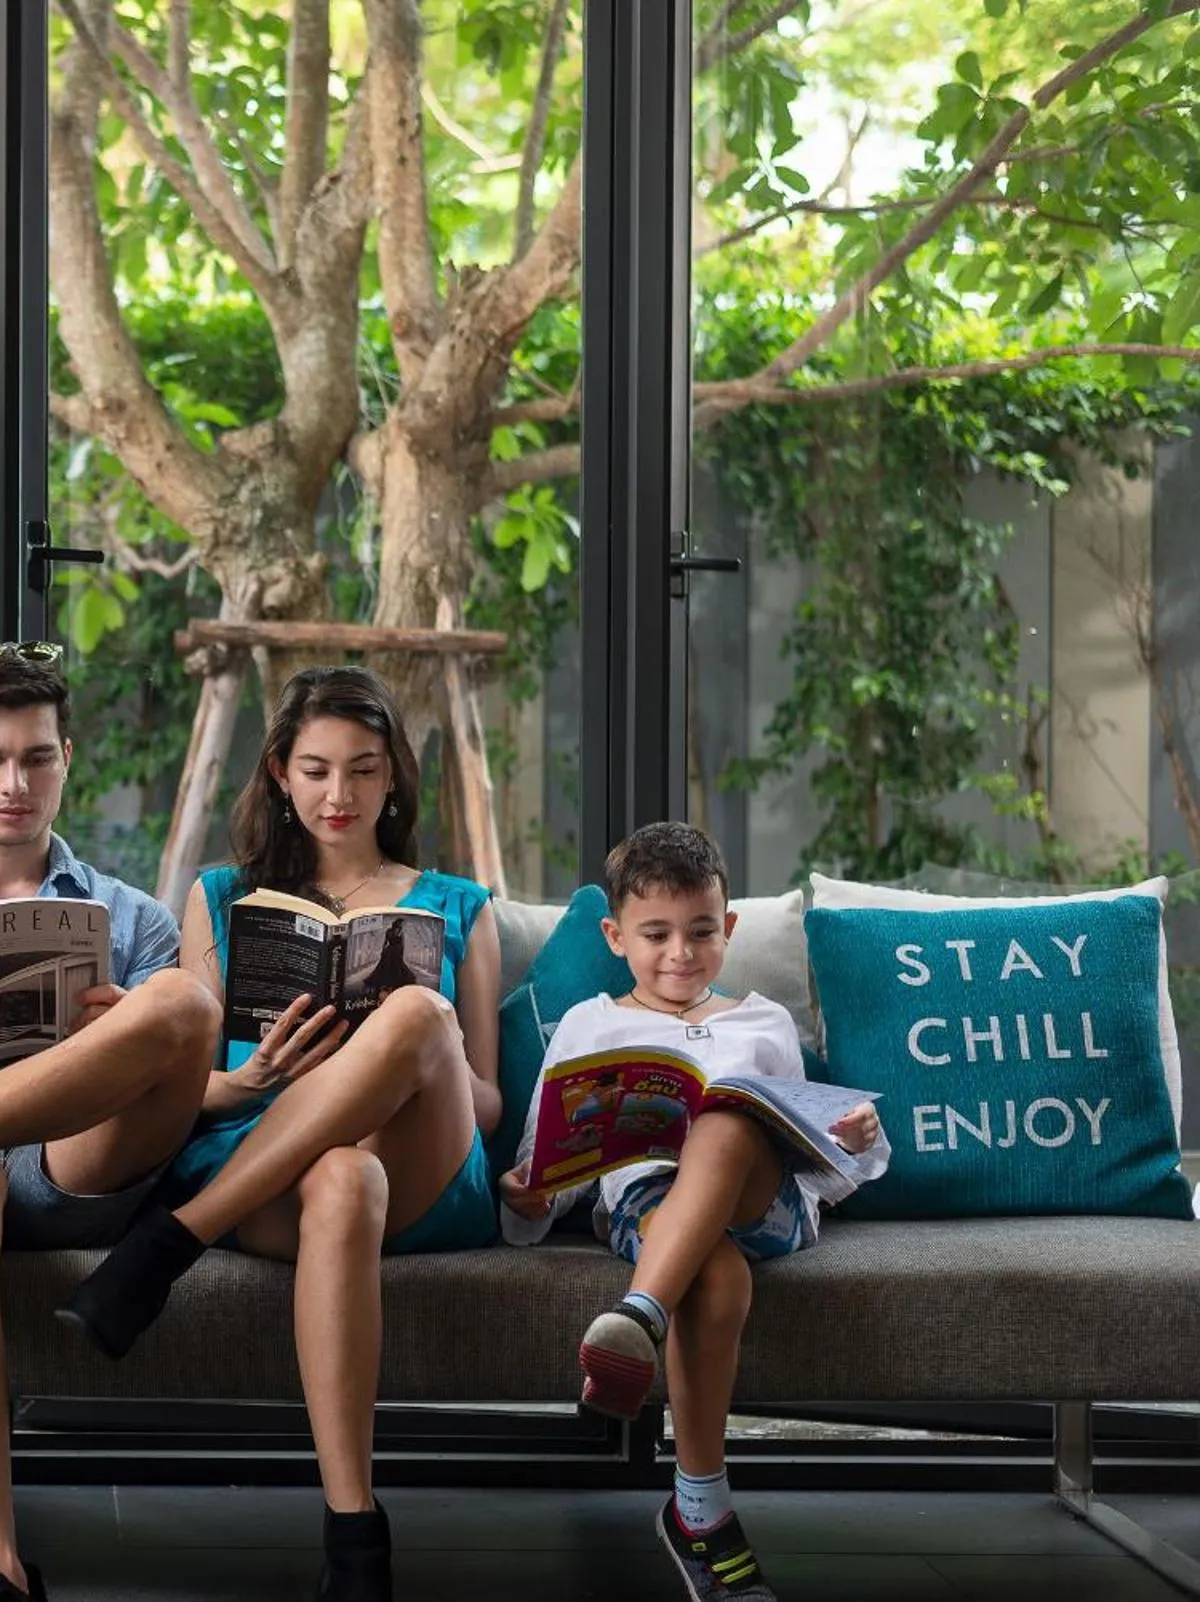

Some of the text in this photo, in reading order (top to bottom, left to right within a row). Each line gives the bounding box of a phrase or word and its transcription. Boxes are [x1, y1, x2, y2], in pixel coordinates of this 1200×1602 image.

[895, 934, 1088, 987] STAY
[907, 1012, 1109, 1065] CHILL
[913, 1097, 1111, 1152] ENJOY
